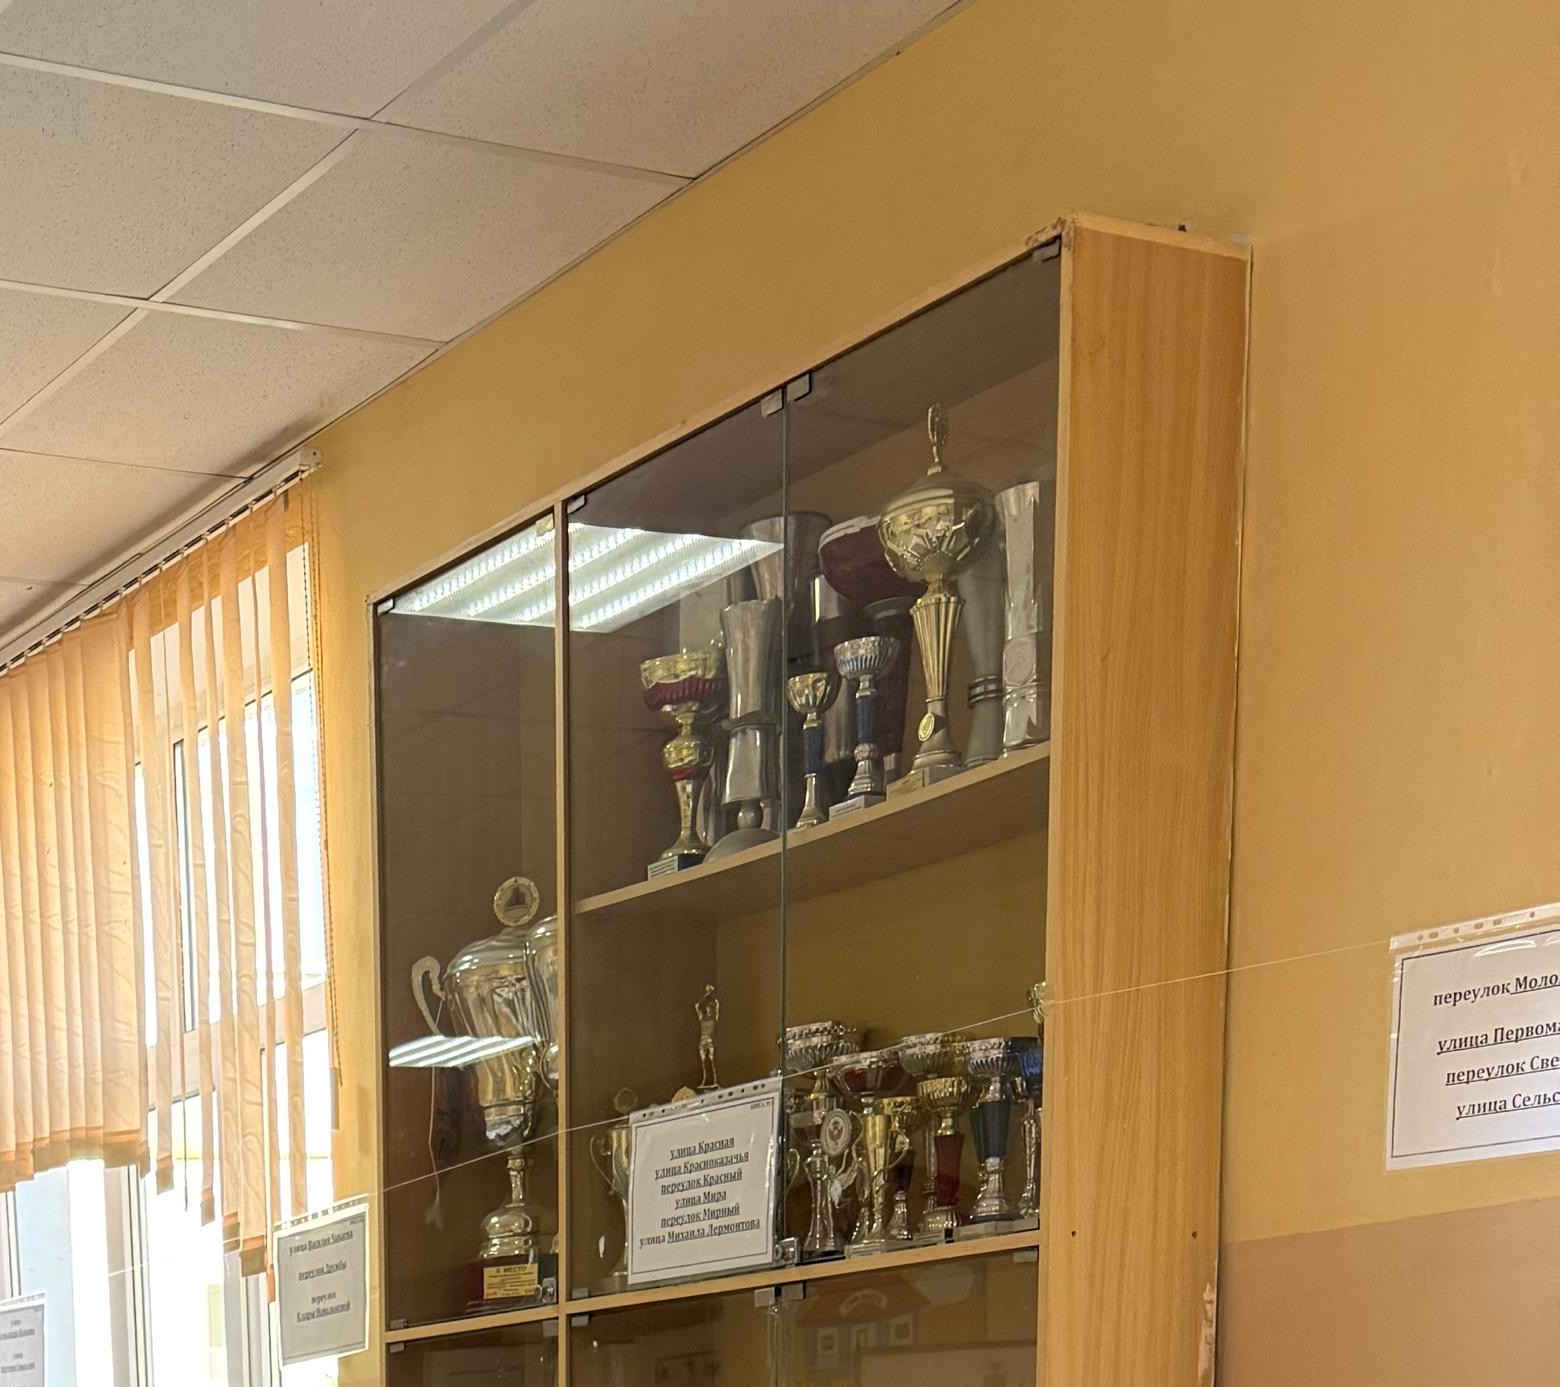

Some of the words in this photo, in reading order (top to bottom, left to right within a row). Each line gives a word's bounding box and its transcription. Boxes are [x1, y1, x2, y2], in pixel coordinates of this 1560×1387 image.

[1433, 980, 1511, 1006] переулок
[1514, 972, 1560, 993] Моло
[1437, 1032, 1488, 1054] улица
[1446, 1060, 1526, 1085] переулок
[1456, 1096, 1507, 1119] улица
[670, 1145, 696, 1160] улица
[698, 1136, 735, 1153] Красная
[654, 1166, 681, 1180] улица
[683, 1151, 749, 1172] Красноказачья
[661, 1178, 701, 1195] переулок
[703, 1168, 743, 1186] Красный
[675, 1194, 701, 1210] улица
[703, 1189, 727, 1203] Мира
[661, 1212, 700, 1228] переулок
[703, 1202, 740, 1220] Мирный
[639, 1235, 666, 1250] улица
[667, 1226, 705, 1244] Михаила
[706, 1218, 761, 1238] Лермонтова
